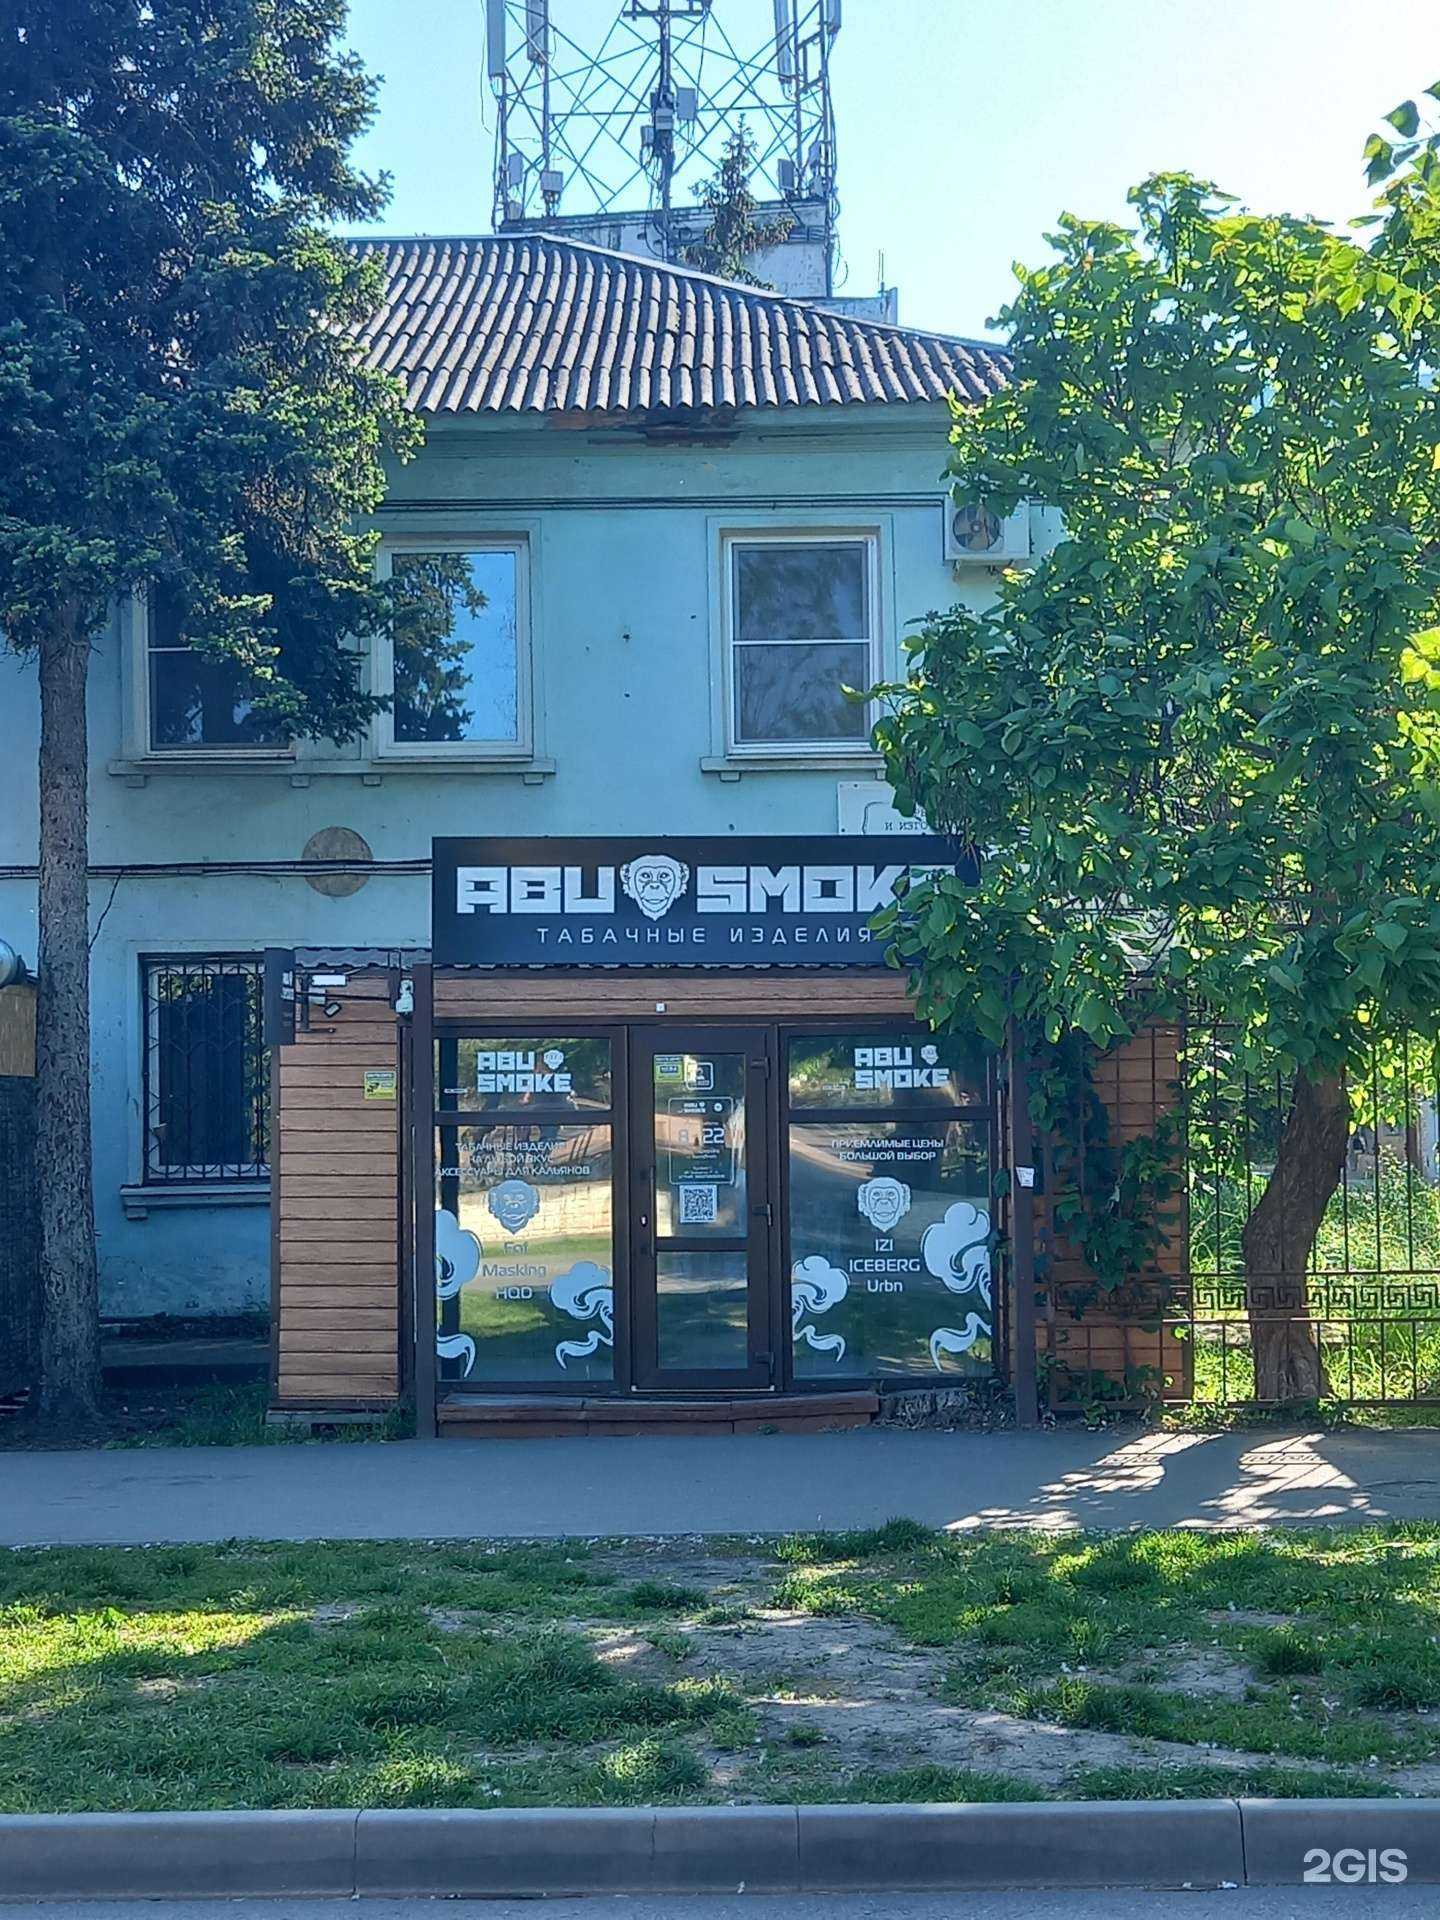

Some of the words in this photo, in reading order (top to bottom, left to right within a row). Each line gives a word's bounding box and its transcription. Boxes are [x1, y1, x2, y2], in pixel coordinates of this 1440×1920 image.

[457, 866, 615, 913] ABU
[697, 865, 956, 913] SMOK
[537, 927, 706, 944] ТАБАЧНЫЕ
[730, 927, 871, 945] ИЗДЕЛИЯ
[477, 1051, 535, 1070] ABU
[854, 1047, 912, 1067] ABU
[477, 1073, 571, 1093] SMOKE
[855, 1068, 950, 1089] SMOKE
[703, 1127, 725, 1144] 22
[912, 1139, 944, 1149] ЦЕНЫ
[840, 1150, 895, 1160] БОЛЬШОЙ
[897, 1151, 936, 1160] ВЫБОР
[505, 1166, 530, 1177] ДЛЯ
[531, 1165, 590, 1176] КАЛЬЯНОВ
[875, 1239, 893, 1251] IZI
[482, 1264, 547, 1279] Masking
[849, 1259, 920, 1272] ICEBERG
[867, 1279, 903, 1292] Urbn
